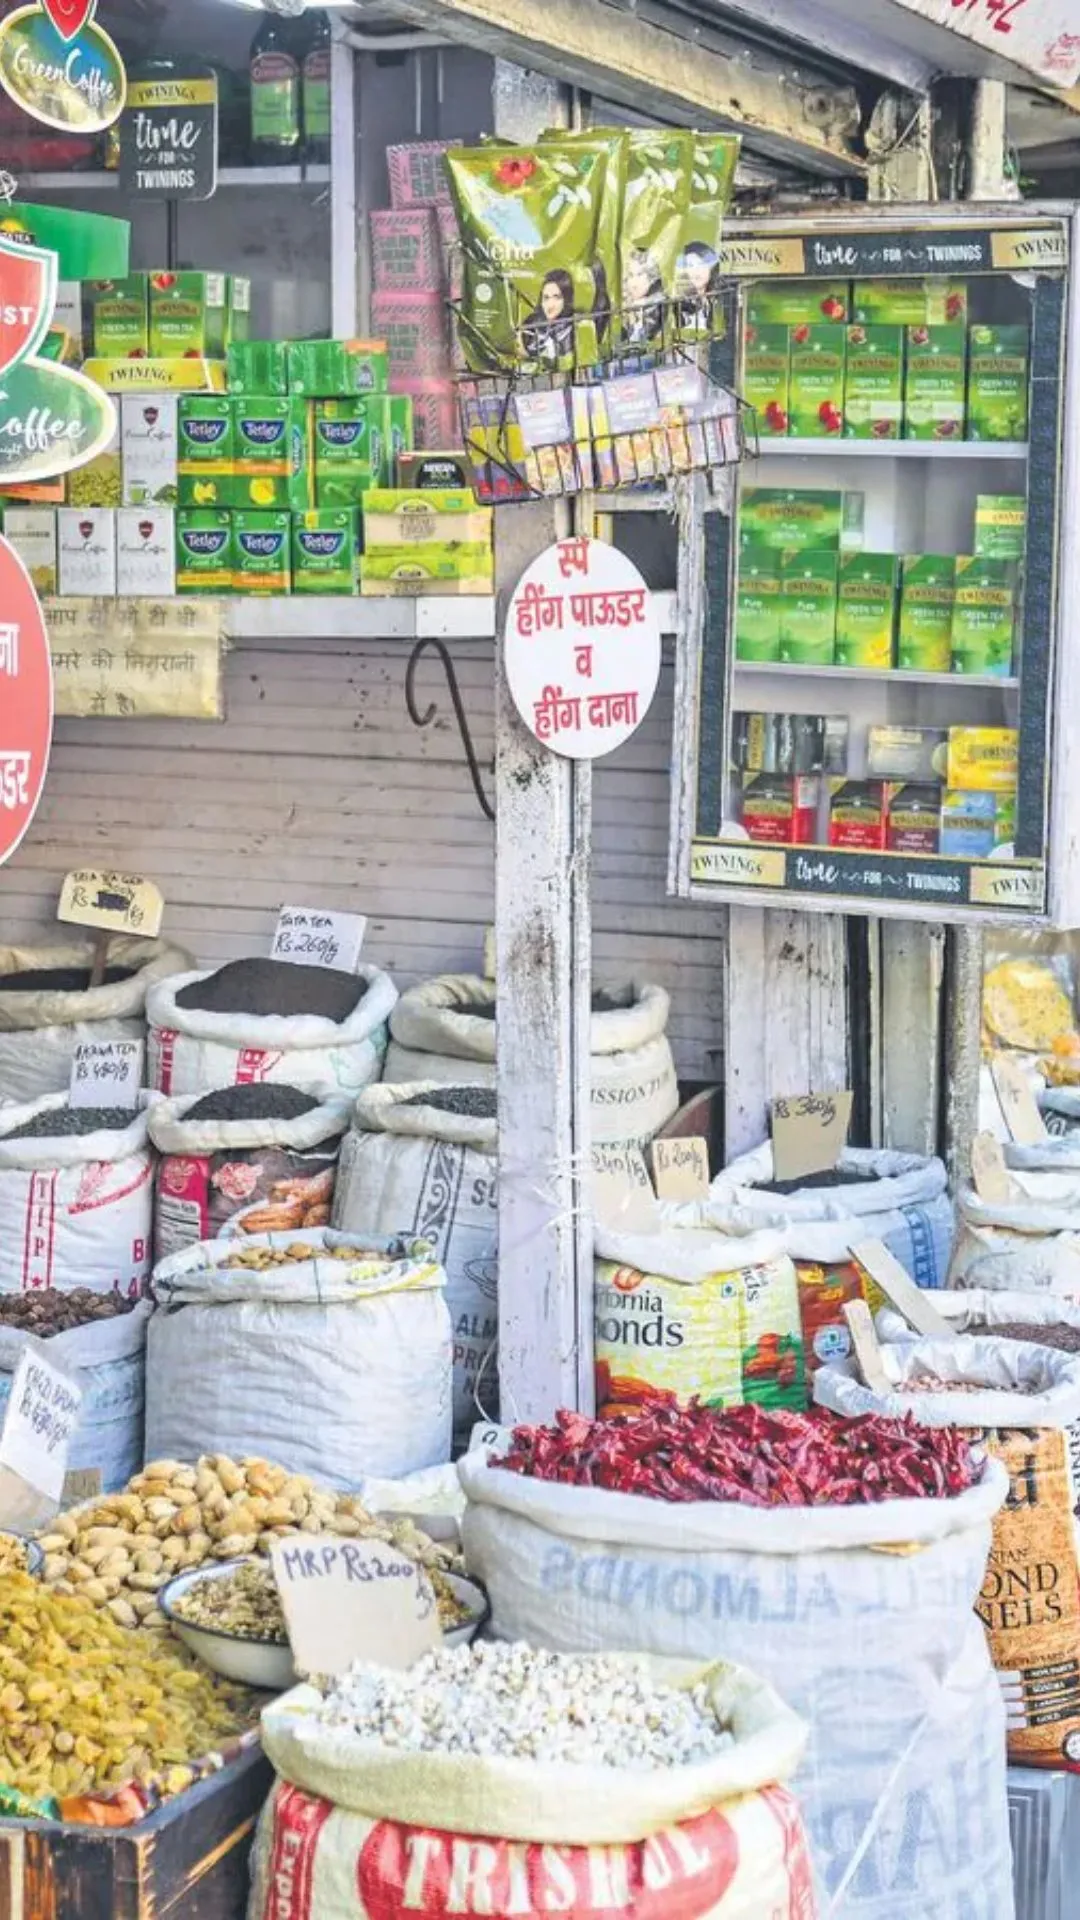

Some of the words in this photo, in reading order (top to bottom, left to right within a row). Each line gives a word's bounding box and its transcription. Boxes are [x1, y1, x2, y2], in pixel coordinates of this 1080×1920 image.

[134, 111, 202, 149] time
[136, 167, 196, 189] TWININGS
[813, 242, 859, 266] time
[926, 244, 983, 262] TWININGS
[109, 366, 174, 383] TWININGS
[187, 421, 222, 440] Tetley
[246, 421, 280, 441] Tetley
[325, 423, 358, 440] Tetley
[187, 532, 223, 551] Tetley
[244, 533, 279, 553] Tetley
[303, 534, 338, 551] Tetley
[515, 583, 564, 637] हींग
[570, 588, 646, 628] पाऊडर
[574, 644, 593, 677] व
[532, 684, 581, 739] हींग
[587, 691, 639, 729] दाना
[795, 857, 839, 883] time
[907, 873, 961, 893] TWININGS
[283, 1546, 337, 1582] MRP
